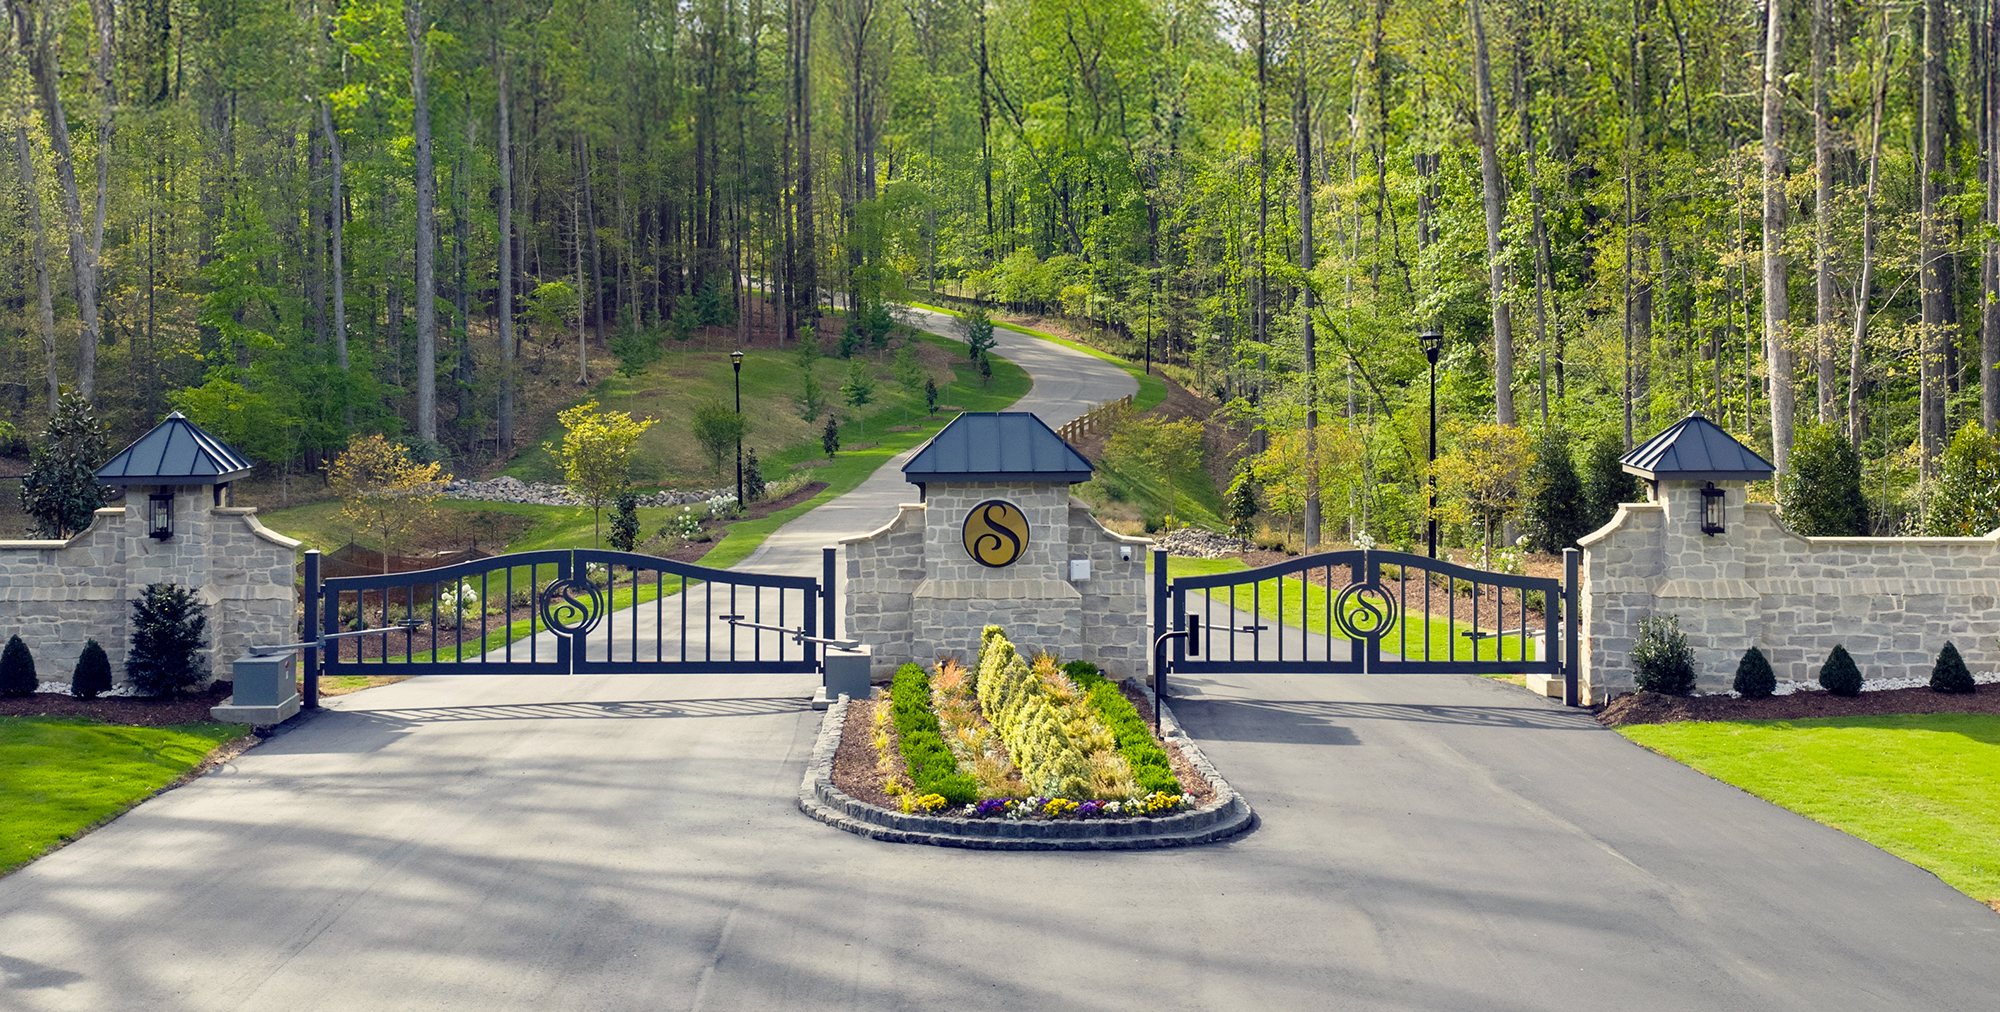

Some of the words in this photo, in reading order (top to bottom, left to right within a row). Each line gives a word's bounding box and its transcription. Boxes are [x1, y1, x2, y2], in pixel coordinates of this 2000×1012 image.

[974, 501, 1021, 566] S
[554, 582, 589, 632] S
[1348, 587, 1383, 634] S
